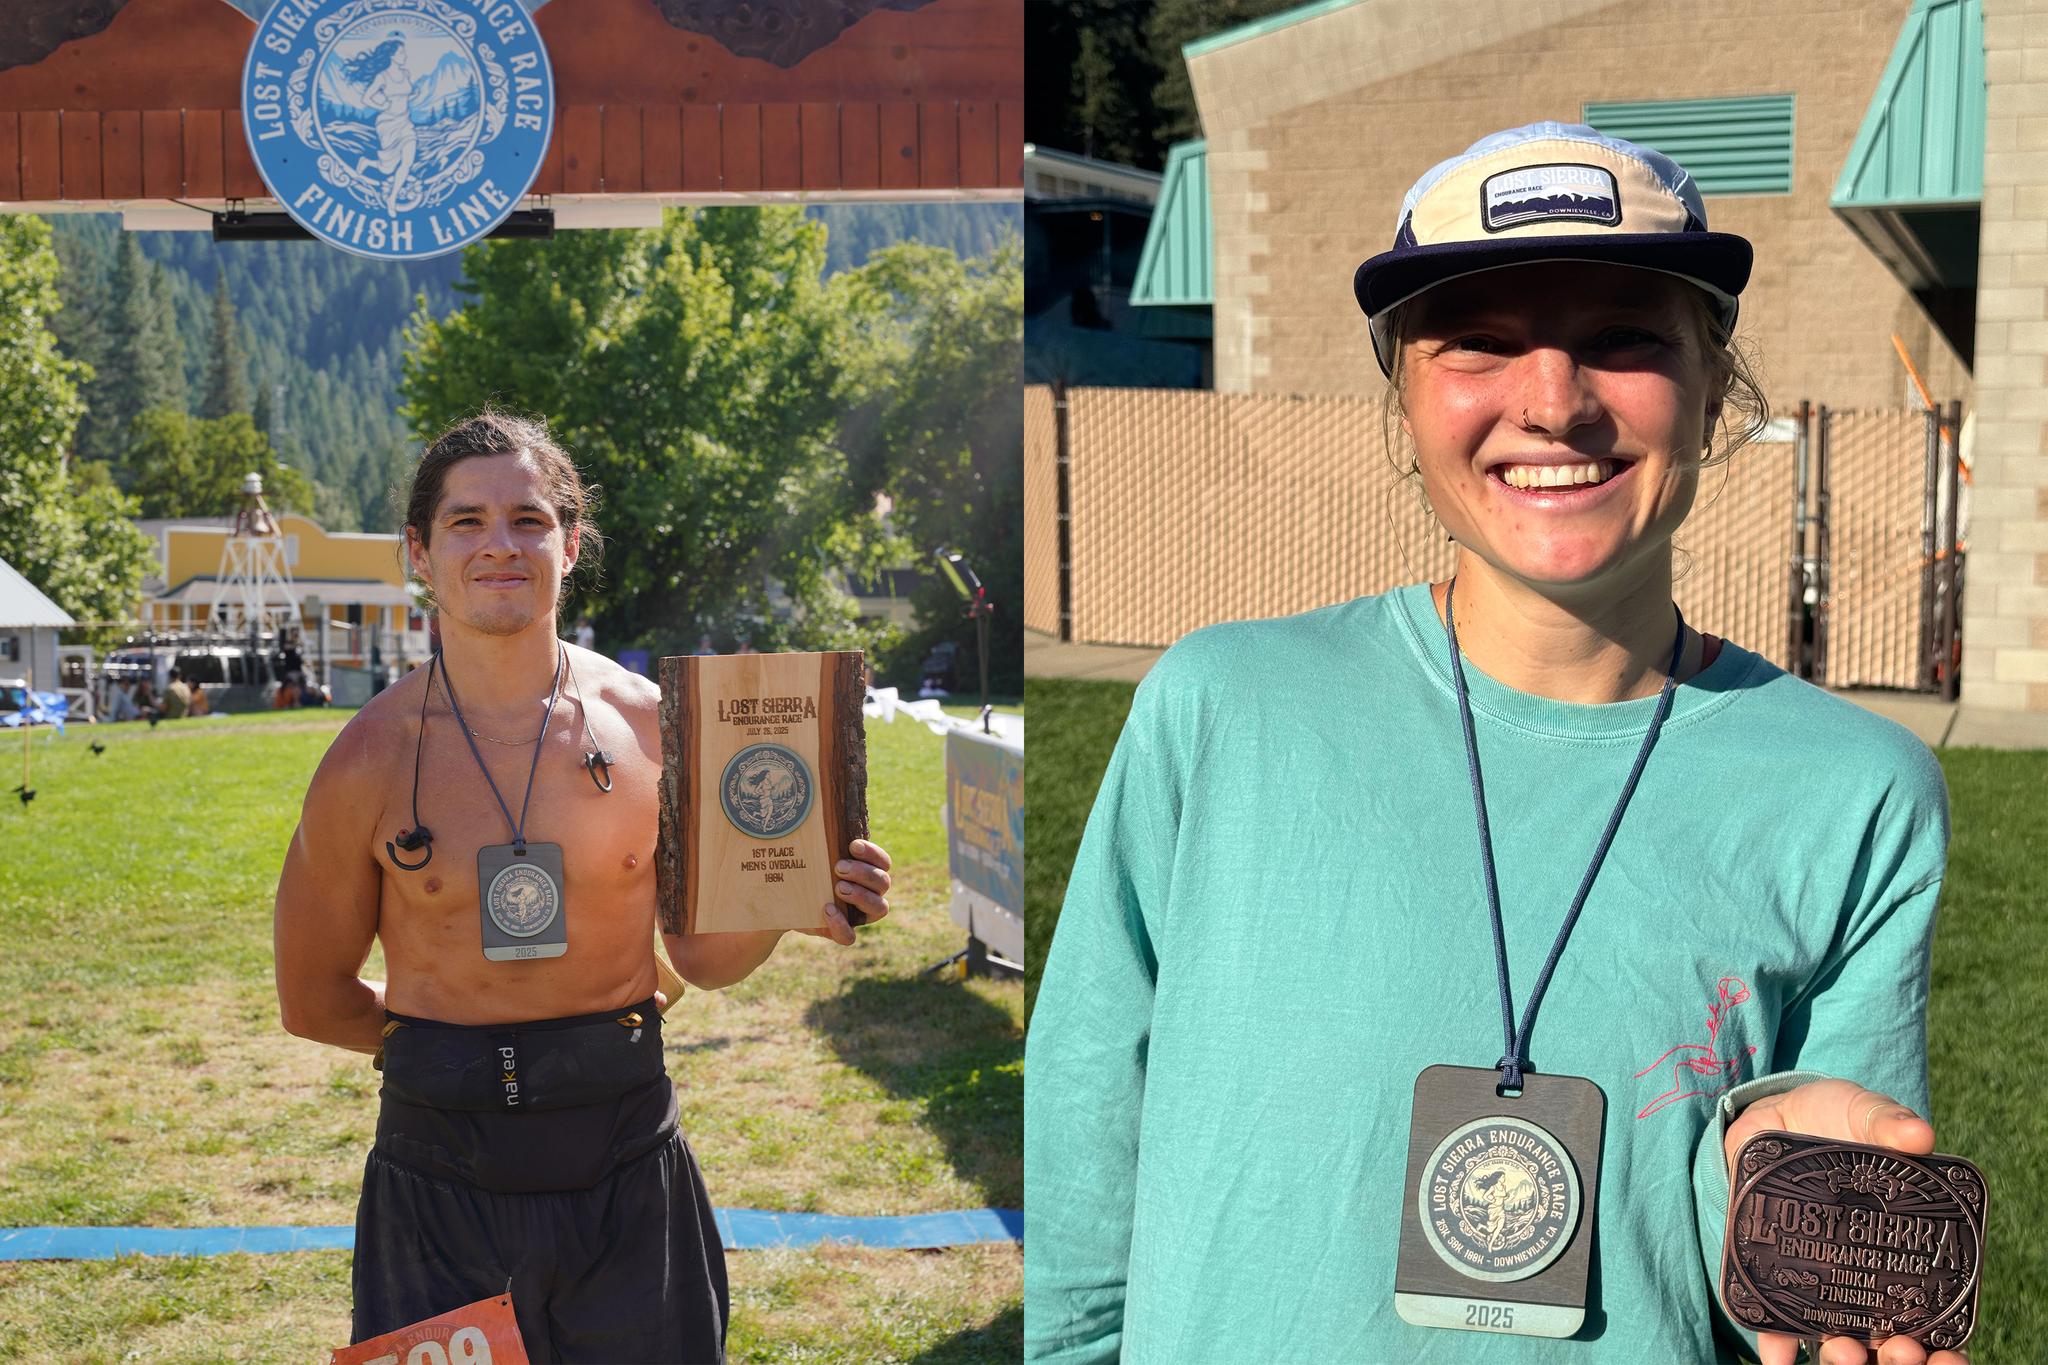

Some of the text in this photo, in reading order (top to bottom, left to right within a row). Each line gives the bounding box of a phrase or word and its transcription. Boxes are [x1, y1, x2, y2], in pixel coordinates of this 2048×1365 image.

[254, 0, 543, 140] LOST SIER RACE
[1494, 168, 1605, 190] LOST SIERRA
[1494, 187, 1527, 198] ENDURANCE
[294, 179, 510, 251] FINISH LINE
[718, 696, 817, 722] LOST SIERRA
[733, 714, 803, 726] ENDURANCE RACE
[747, 727, 761, 736] JULY
[774, 726, 789, 735] 2025
[752, 847, 795, 858] 1ST PLACE
[769, 859, 807, 870] OVERALL
[515, 947, 537, 958] 2025
[499, 1047, 519, 1105] naked
[1434, 1130, 1566, 1220] LOST SIERRA ENDURANCE RACE
[1546, 1226, 1558, 1238] CA
[1750, 1193, 1961, 1270] LOST SIERRA
[1780, 1236, 1931, 1276] ENDURANCE RACE
[1831, 1268, 1877, 1289] 100KM
[1819, 1285, 1885, 1309] FINISHER
[1465, 1304, 1514, 1329] 2025
[1803, 1306, 1895, 1332] DOWNIEVILLE, CA
[408, 1326, 450, 1346] ENDUR
